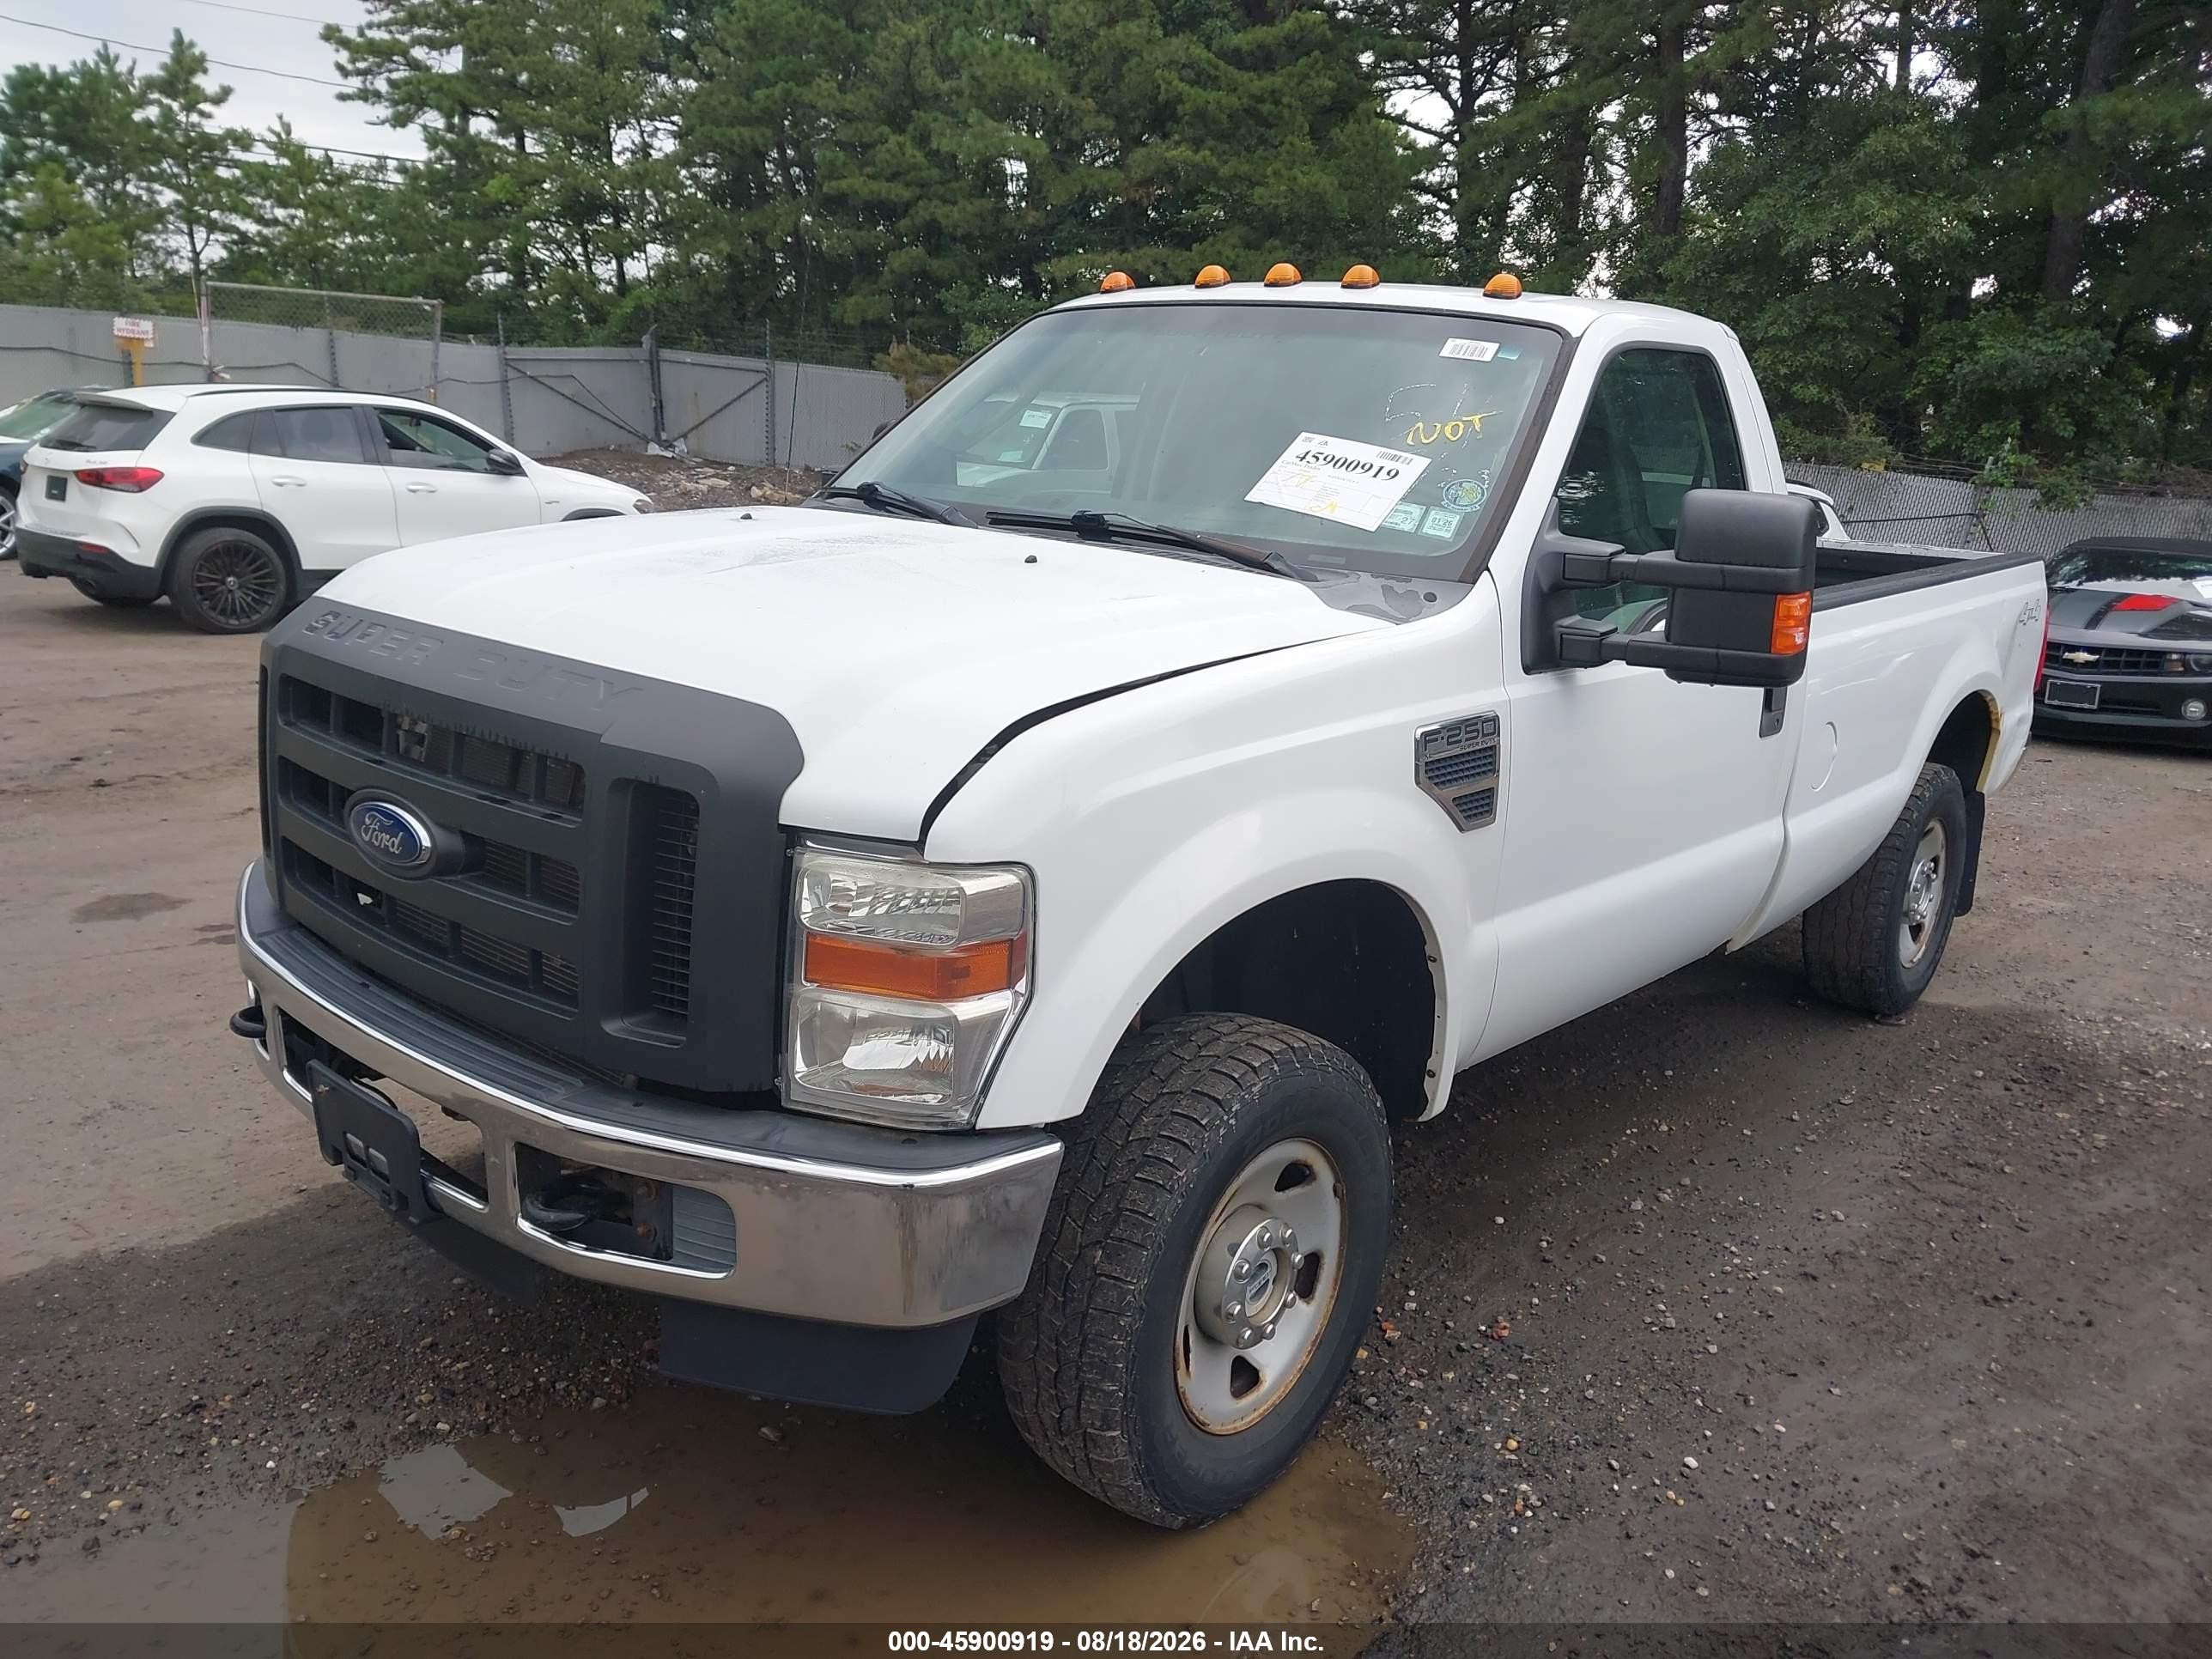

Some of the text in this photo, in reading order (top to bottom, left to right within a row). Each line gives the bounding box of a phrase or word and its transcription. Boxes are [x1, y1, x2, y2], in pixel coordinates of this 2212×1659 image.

[1406, 410, 1504, 446] NOT
[1294, 449, 1400, 482] 45900919
[1401, 516, 1416, 525] 27
[301, 611, 646, 711] SUPER DUTY
[1459, 738, 1496, 751] SUPER DUTY
[361, 811, 404, 854] Ford
